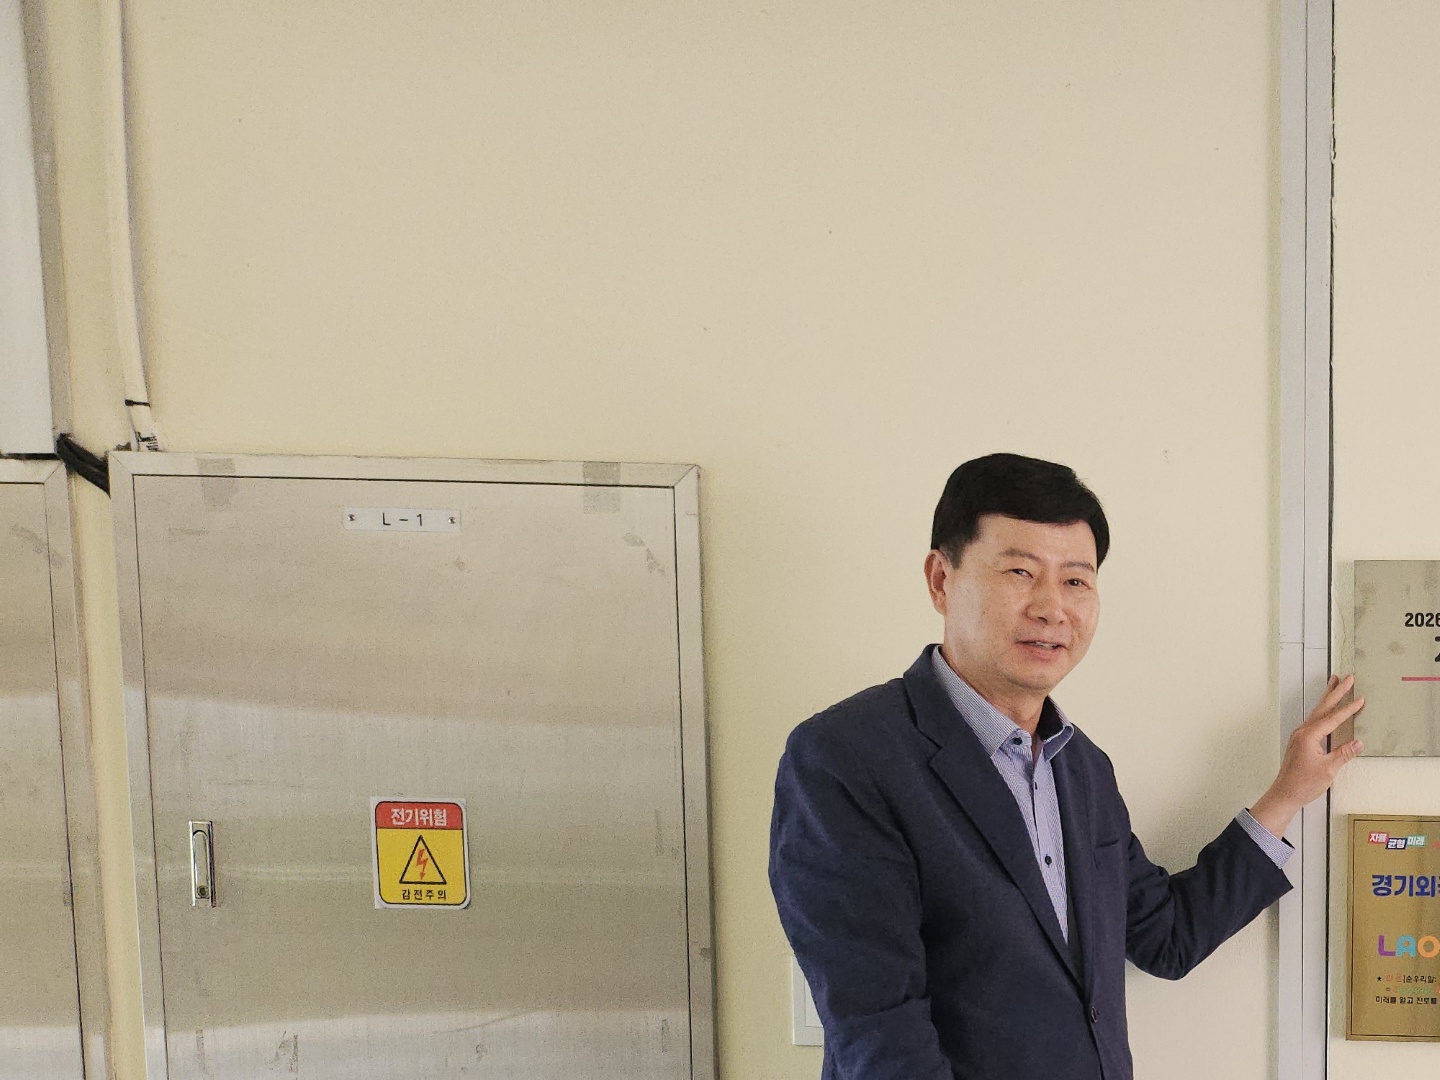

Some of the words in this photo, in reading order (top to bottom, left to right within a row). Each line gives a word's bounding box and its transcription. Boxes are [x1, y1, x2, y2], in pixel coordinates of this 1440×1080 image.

[391, 808, 447, 827] 전기위험
[1387, 838, 1406, 849] 균형
[1407, 836, 1426, 846] 미래
[401, 889, 447, 901] 감전주의
